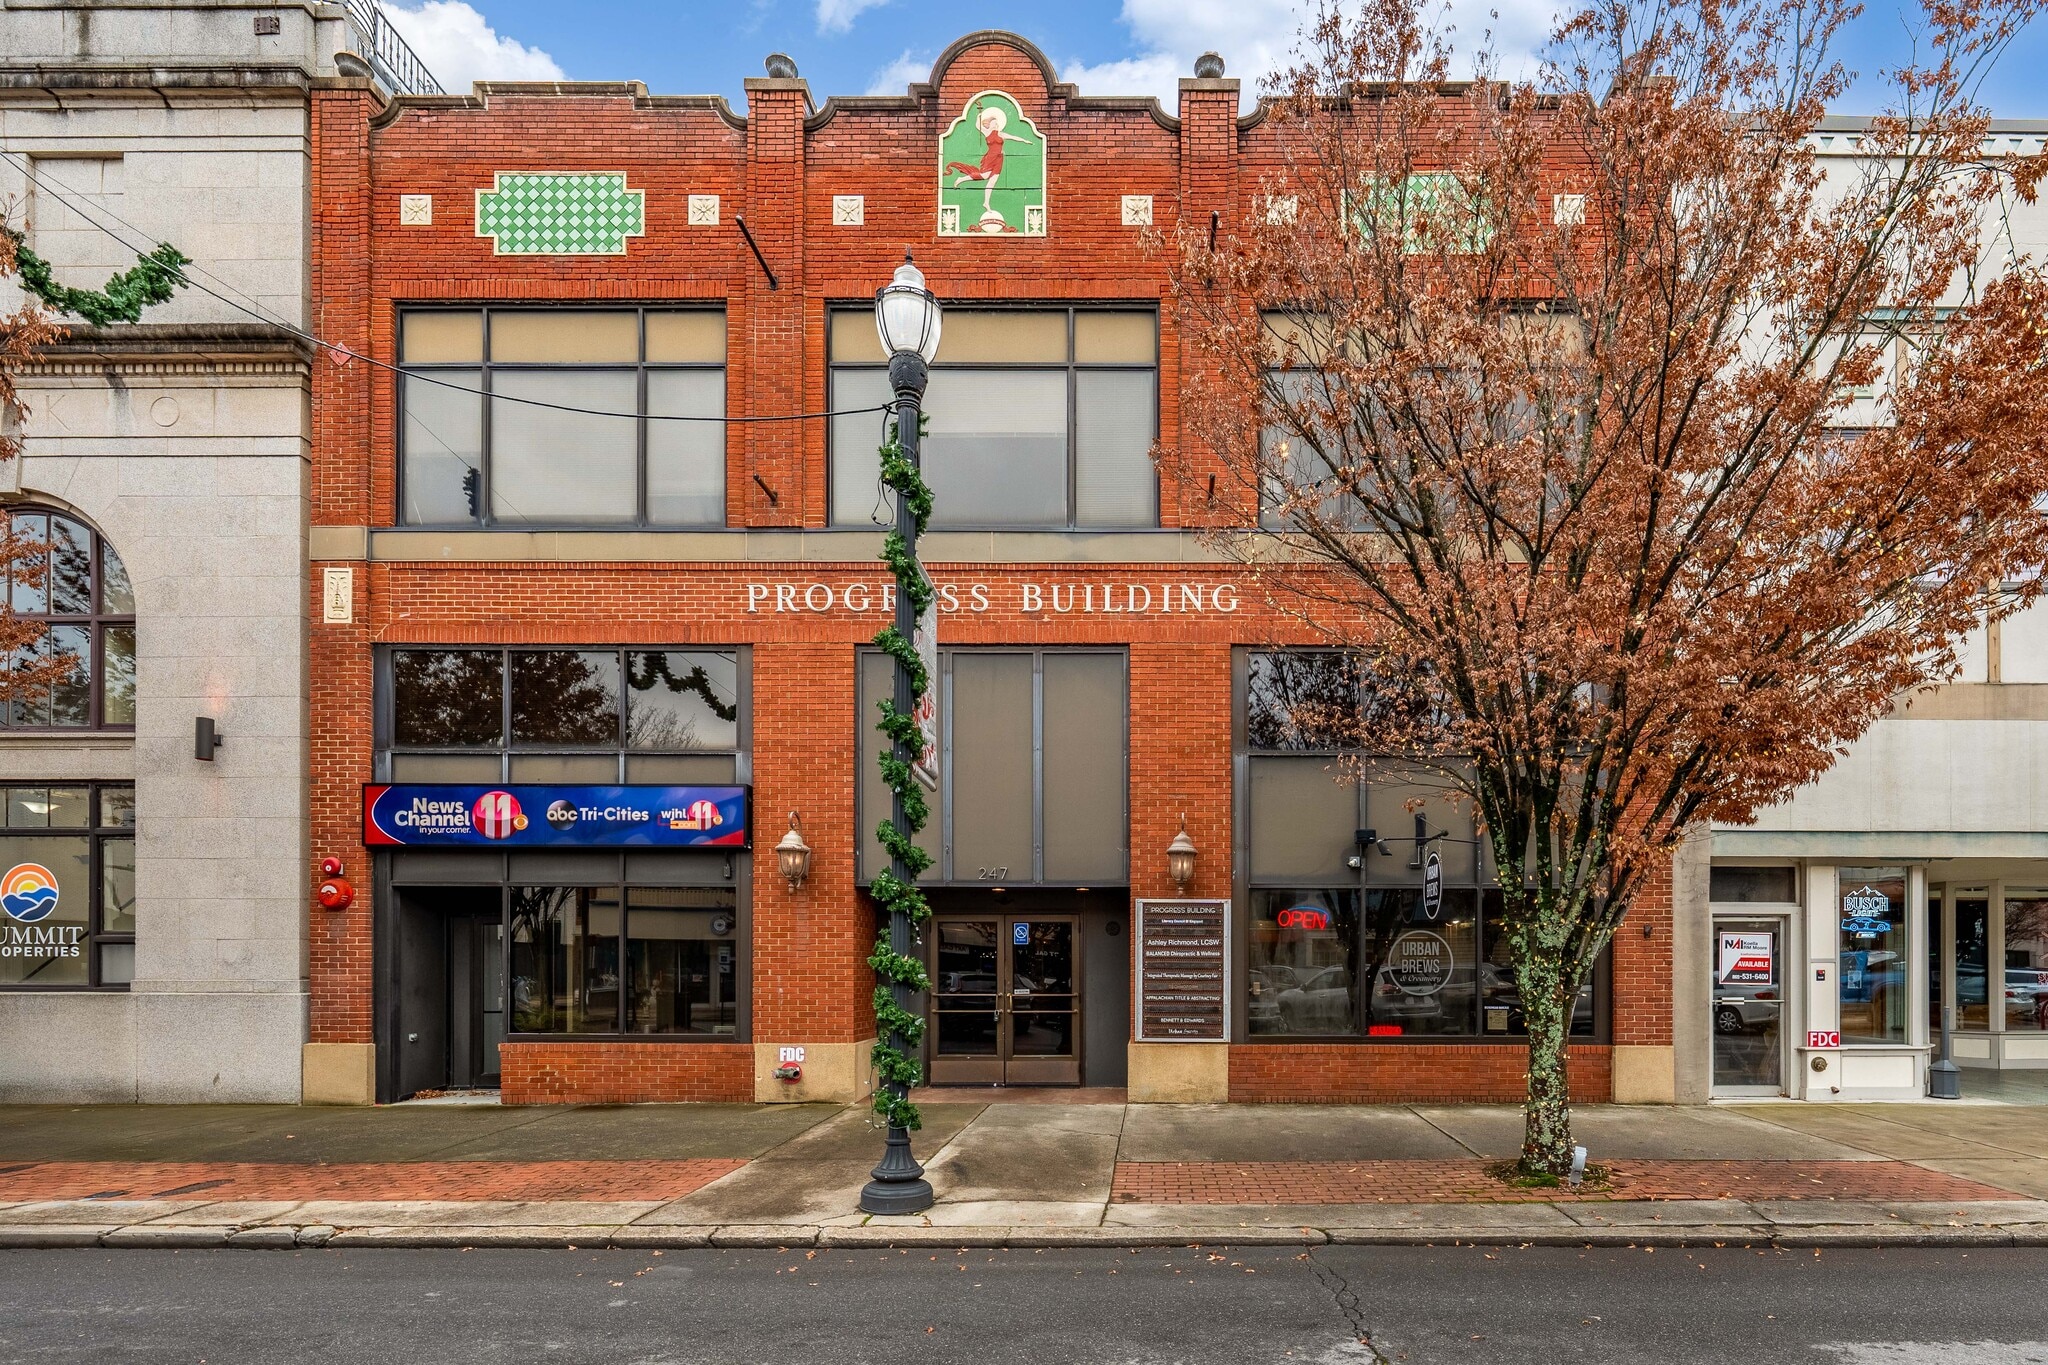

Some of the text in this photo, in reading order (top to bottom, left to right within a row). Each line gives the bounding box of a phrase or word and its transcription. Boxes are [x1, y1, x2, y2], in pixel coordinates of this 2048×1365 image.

[746, 583, 1240, 613] PROGRSS BUILDING
[412, 797, 464, 814] News
[394, 810, 471, 827] Channel
[480, 794, 511, 839] 11
[546, 807, 650, 821] abc Tri-Cities
[660, 807, 687, 821] wjhl
[427, 827, 446, 836] your
[978, 866, 1009, 880] 247
[1843, 896, 1889, 912] BUSCH
[1277, 909, 1328, 930] OPEN
[1147, 939, 1167, 947] Ashley
[1402, 941, 1439, 957] URBAN
[1724, 937, 1743, 950] NAI
[1402, 959, 1440, 974] BREWS
[1737, 960, 1769, 968] AVAILABLE
[1407, 974, 1442, 984] Creamery
[1809, 1032, 1838, 1047] FDC
[779, 1047, 805, 1062] FDC
